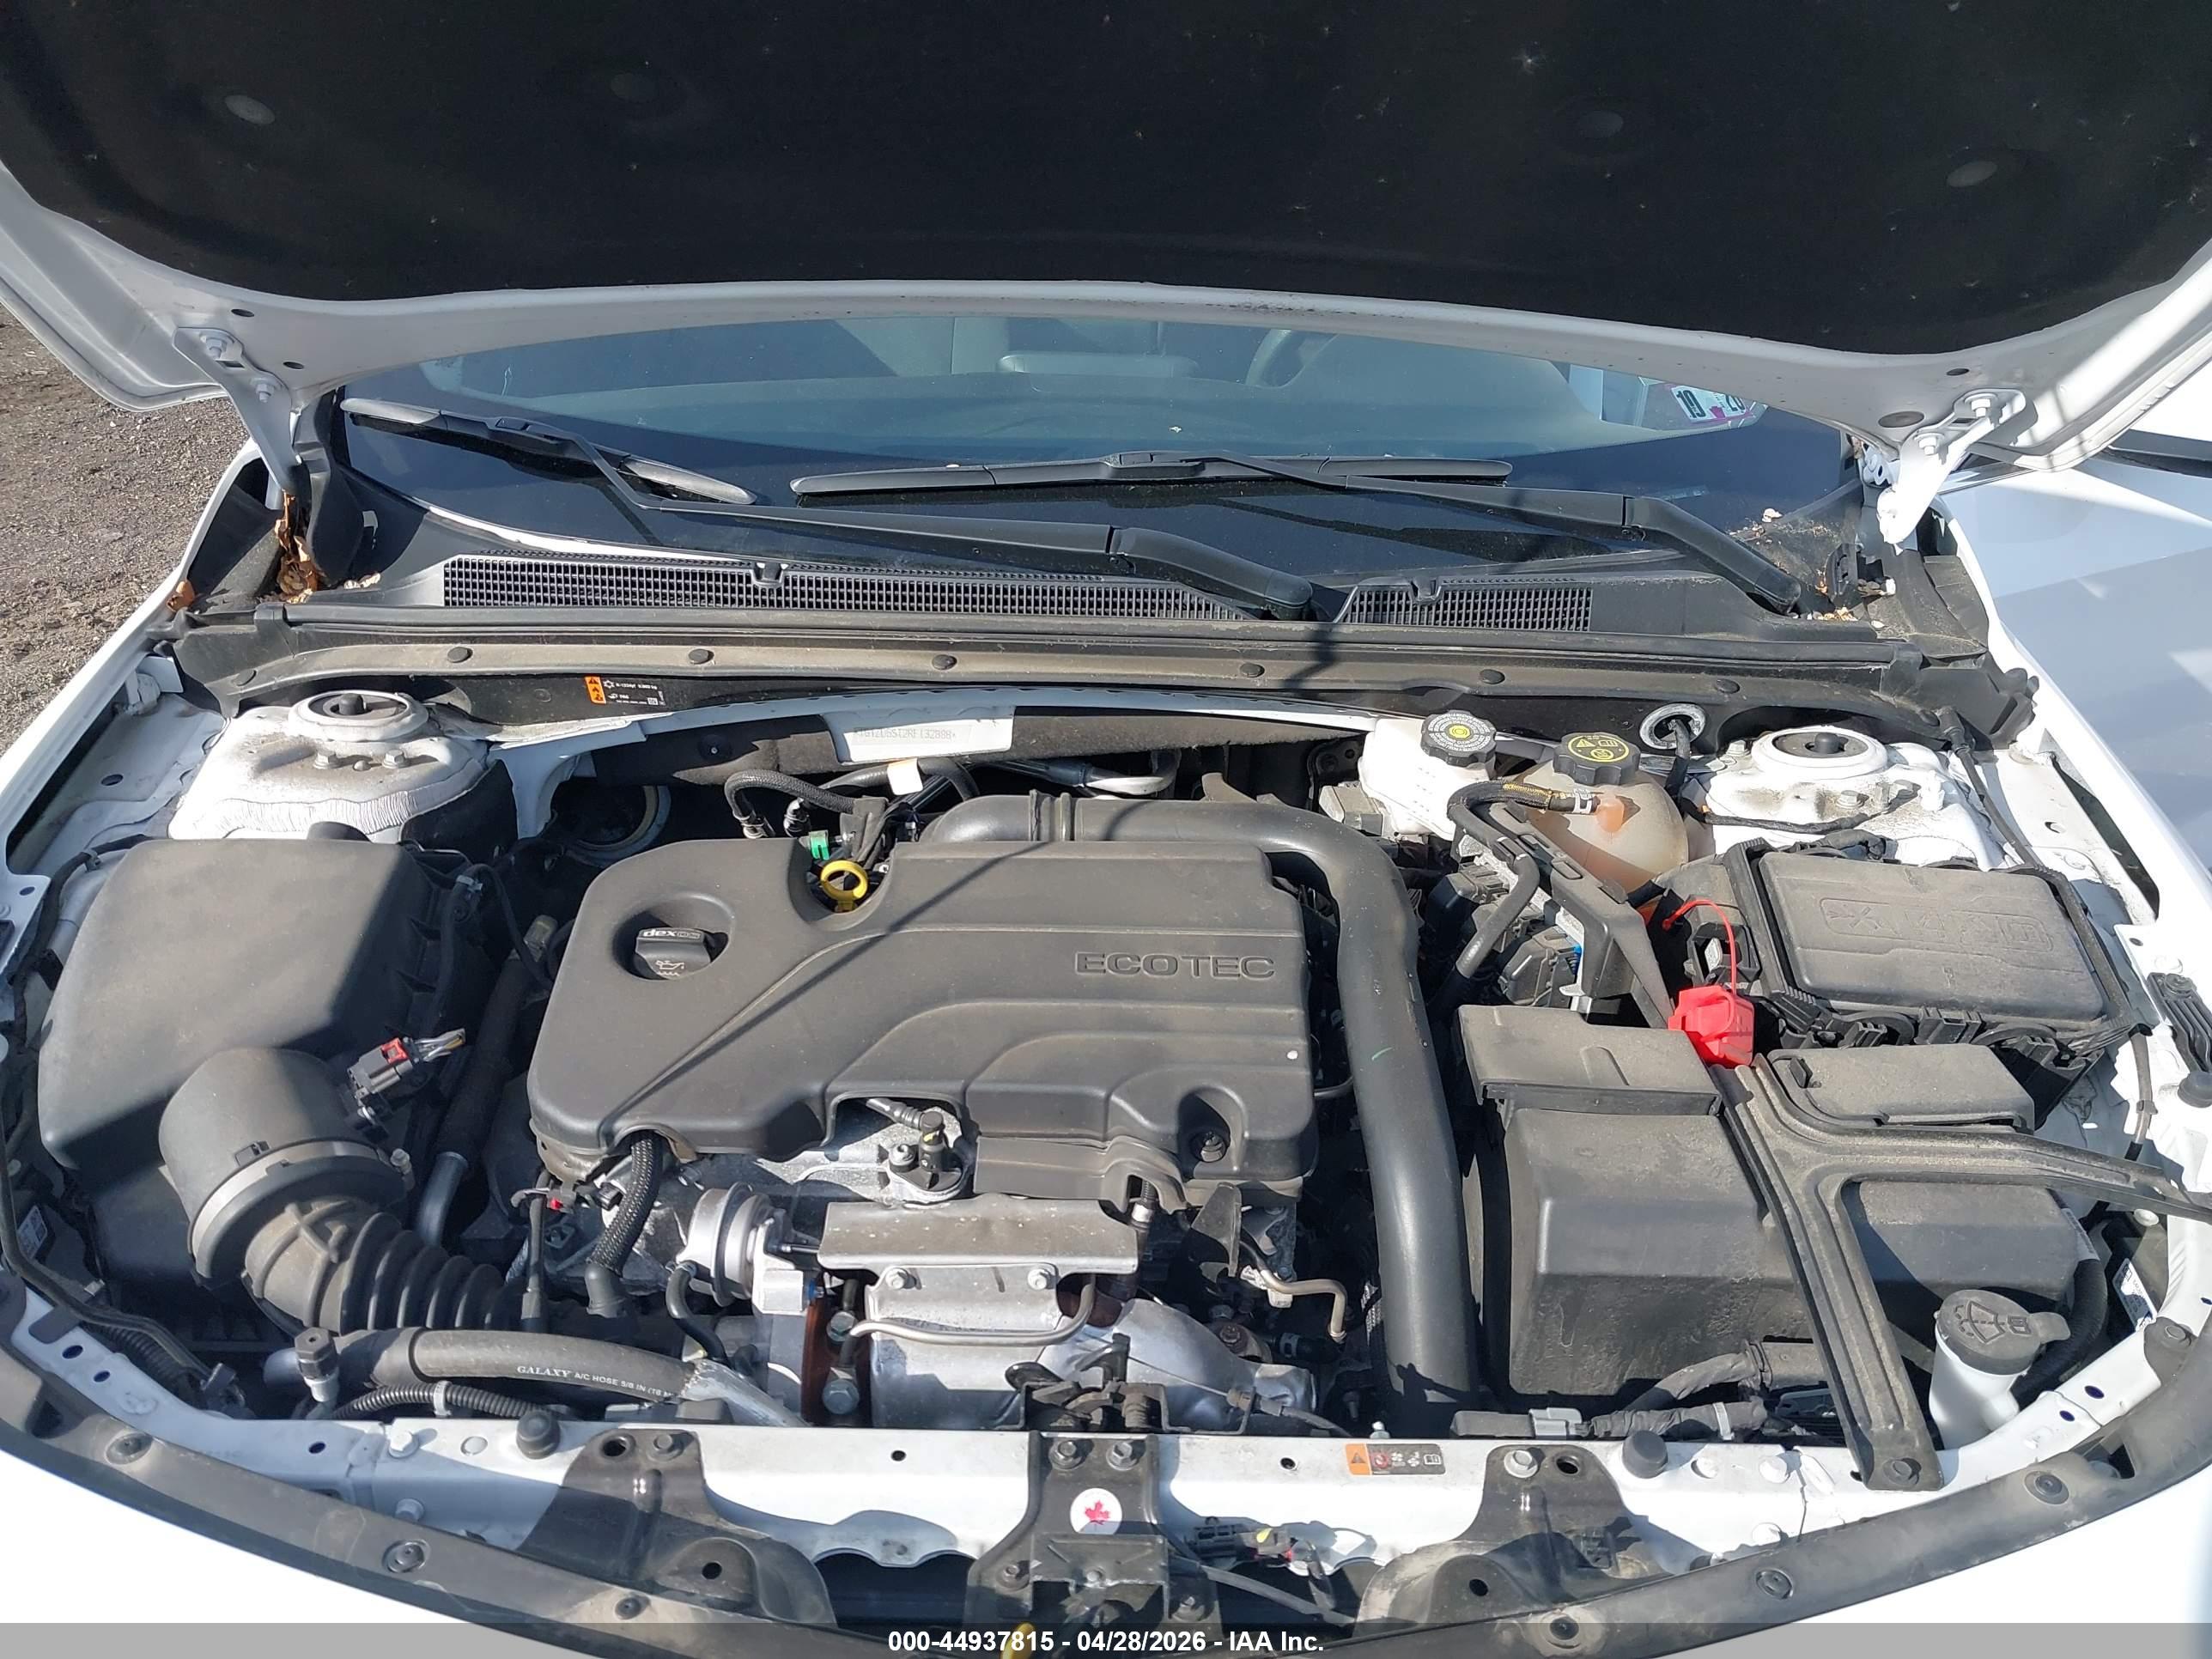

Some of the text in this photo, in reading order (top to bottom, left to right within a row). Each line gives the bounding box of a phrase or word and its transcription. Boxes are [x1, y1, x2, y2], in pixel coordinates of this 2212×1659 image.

[1675, 389, 1707, 419] 10
[1075, 951, 1276, 981] ECOTEC
[517, 1365, 572, 1378] GALAXY
[574, 1372, 590, 1381] A/C
[592, 1375, 618, 1386] HOSE
[636, 1383, 647, 1392] IN
